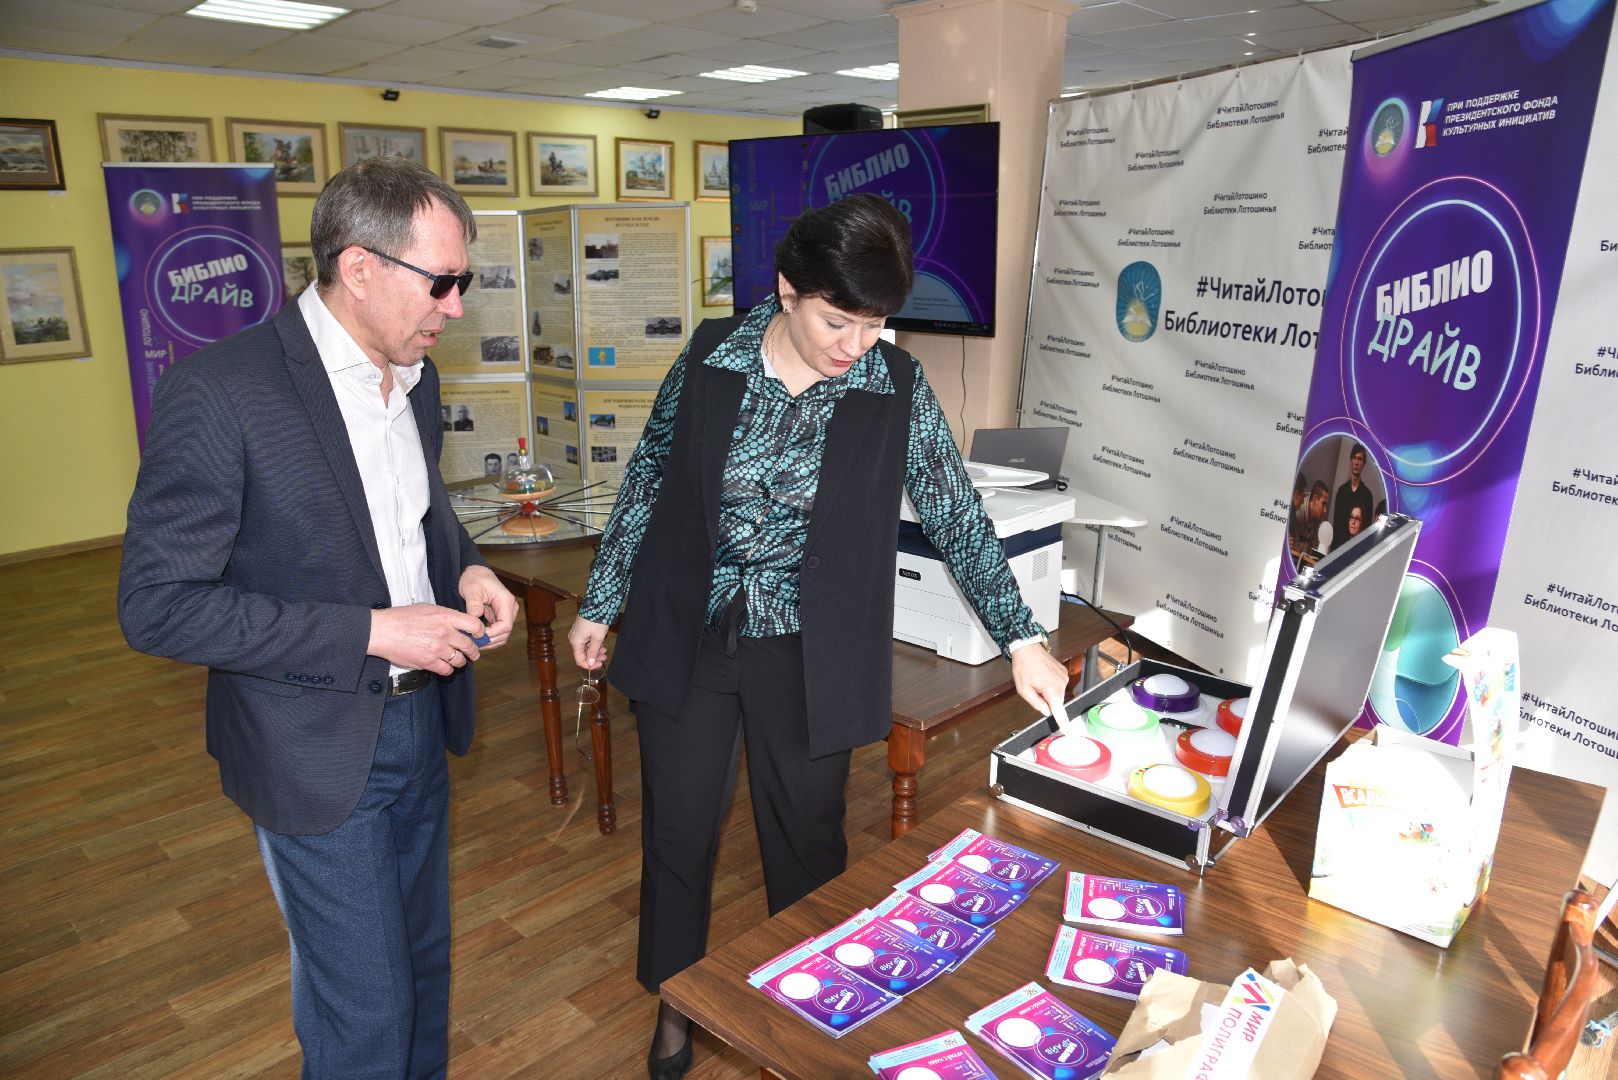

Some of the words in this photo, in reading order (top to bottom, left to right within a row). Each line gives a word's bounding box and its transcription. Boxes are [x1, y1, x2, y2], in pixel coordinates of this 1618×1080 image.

[1444, 104, 1521, 124] ПРЕЗИДЕНТСКОГО
[1522, 95, 1559, 111] ФОНДА
[1446, 101, 1464, 112] ПРИ
[1465, 89, 1520, 109] ПОДДЕРЖКЕ
[1442, 119, 1497, 137] КУЛЬТУРНЫХ
[1498, 109, 1556, 127] ИНИЦИАТИВ
[823, 143, 911, 201] БИБЛИО
[167, 252, 249, 288] БИБЛИО
[170, 281, 254, 308] ДРАЙВ
[1196, 275, 1326, 308] #ЧитайЛото
[1375, 249, 1494, 322] БИБЛИО
[1164, 309, 1278, 346] Библиотеки
[1366, 311, 1482, 392] ДРАЙВ
[1172, 447, 1209, 466] Библиотеки
[1183, 438, 1237, 460] #ЧитайЛотошино
[1160, 523, 1195, 543] Библиотеки
[1169, 514, 1222, 542] #ЧитайЛотошино
[1155, 600, 1190, 622] Библиотеки
[1165, 592, 1218, 623] #ЧитайЛотошино
[1523, 593, 1598, 627] Библиотеки
[1241, 1010, 1265, 1043] МИР
